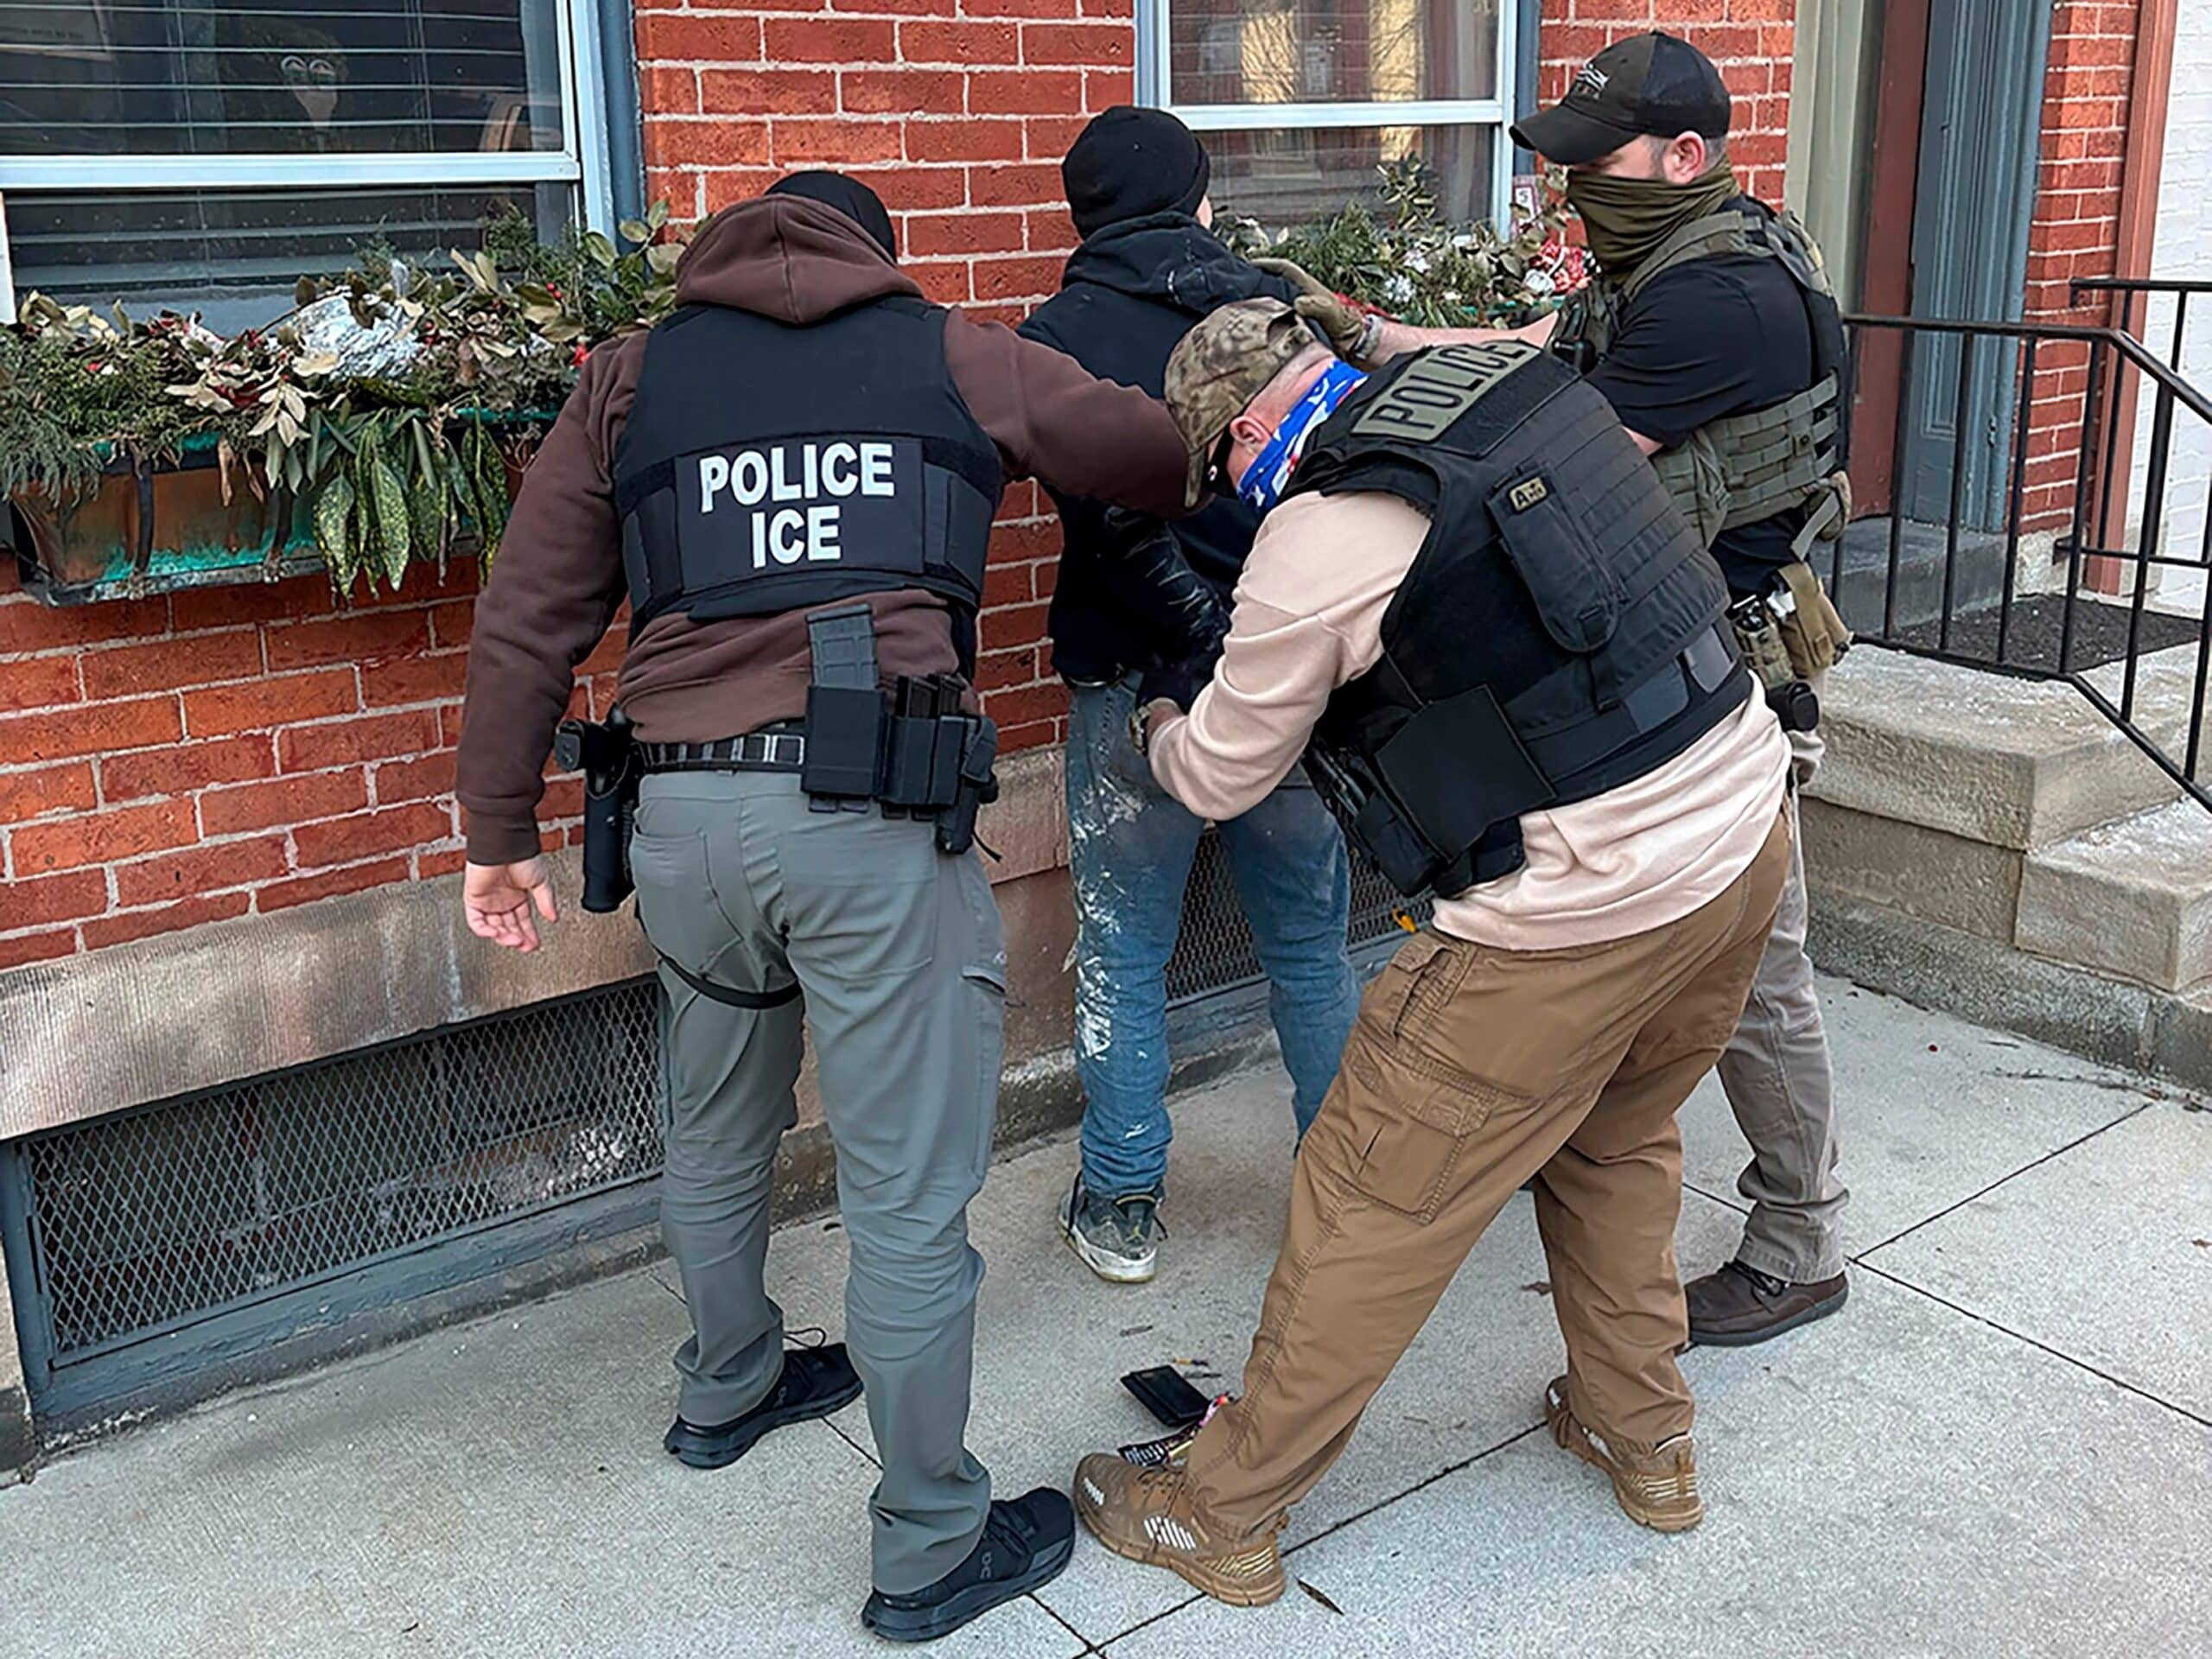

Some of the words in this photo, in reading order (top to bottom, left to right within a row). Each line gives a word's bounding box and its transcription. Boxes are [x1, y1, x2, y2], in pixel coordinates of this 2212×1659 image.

[1368, 344, 1528, 429] POLICE
[699, 442, 895, 513] POLICE
[751, 505, 842, 569] ICE
